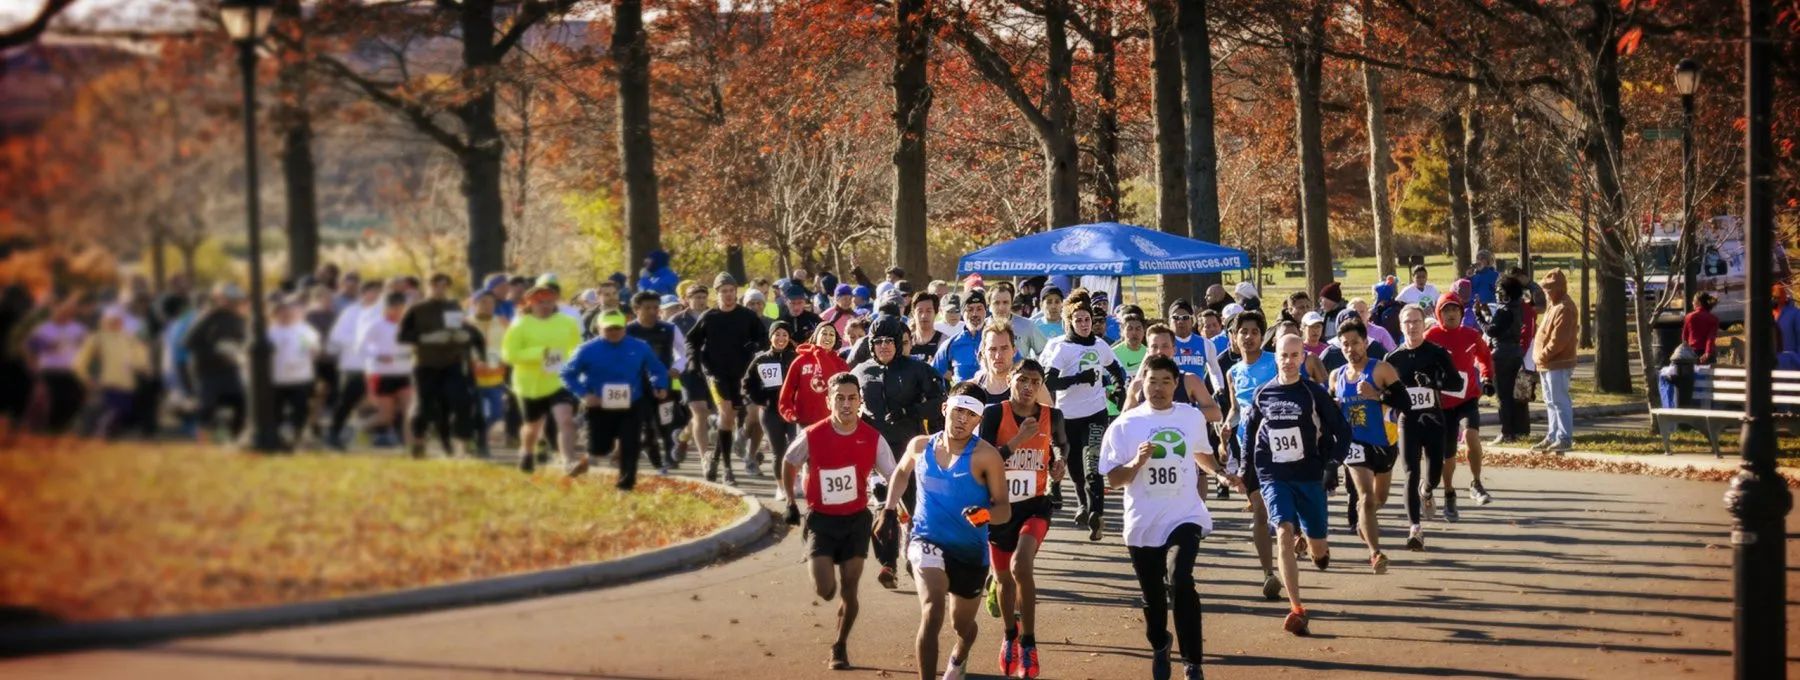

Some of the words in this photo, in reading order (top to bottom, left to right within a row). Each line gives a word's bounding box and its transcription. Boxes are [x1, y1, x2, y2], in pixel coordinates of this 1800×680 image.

[1139, 256, 1241, 272] srichinmoyraces.org
[762, 368, 778, 379] 697
[606, 389, 629, 400] 364
[1410, 393, 1431, 406] 384
[1273, 435, 1298, 452] 394
[825, 474, 853, 493] 392
[1148, 466, 1177, 485] 386
